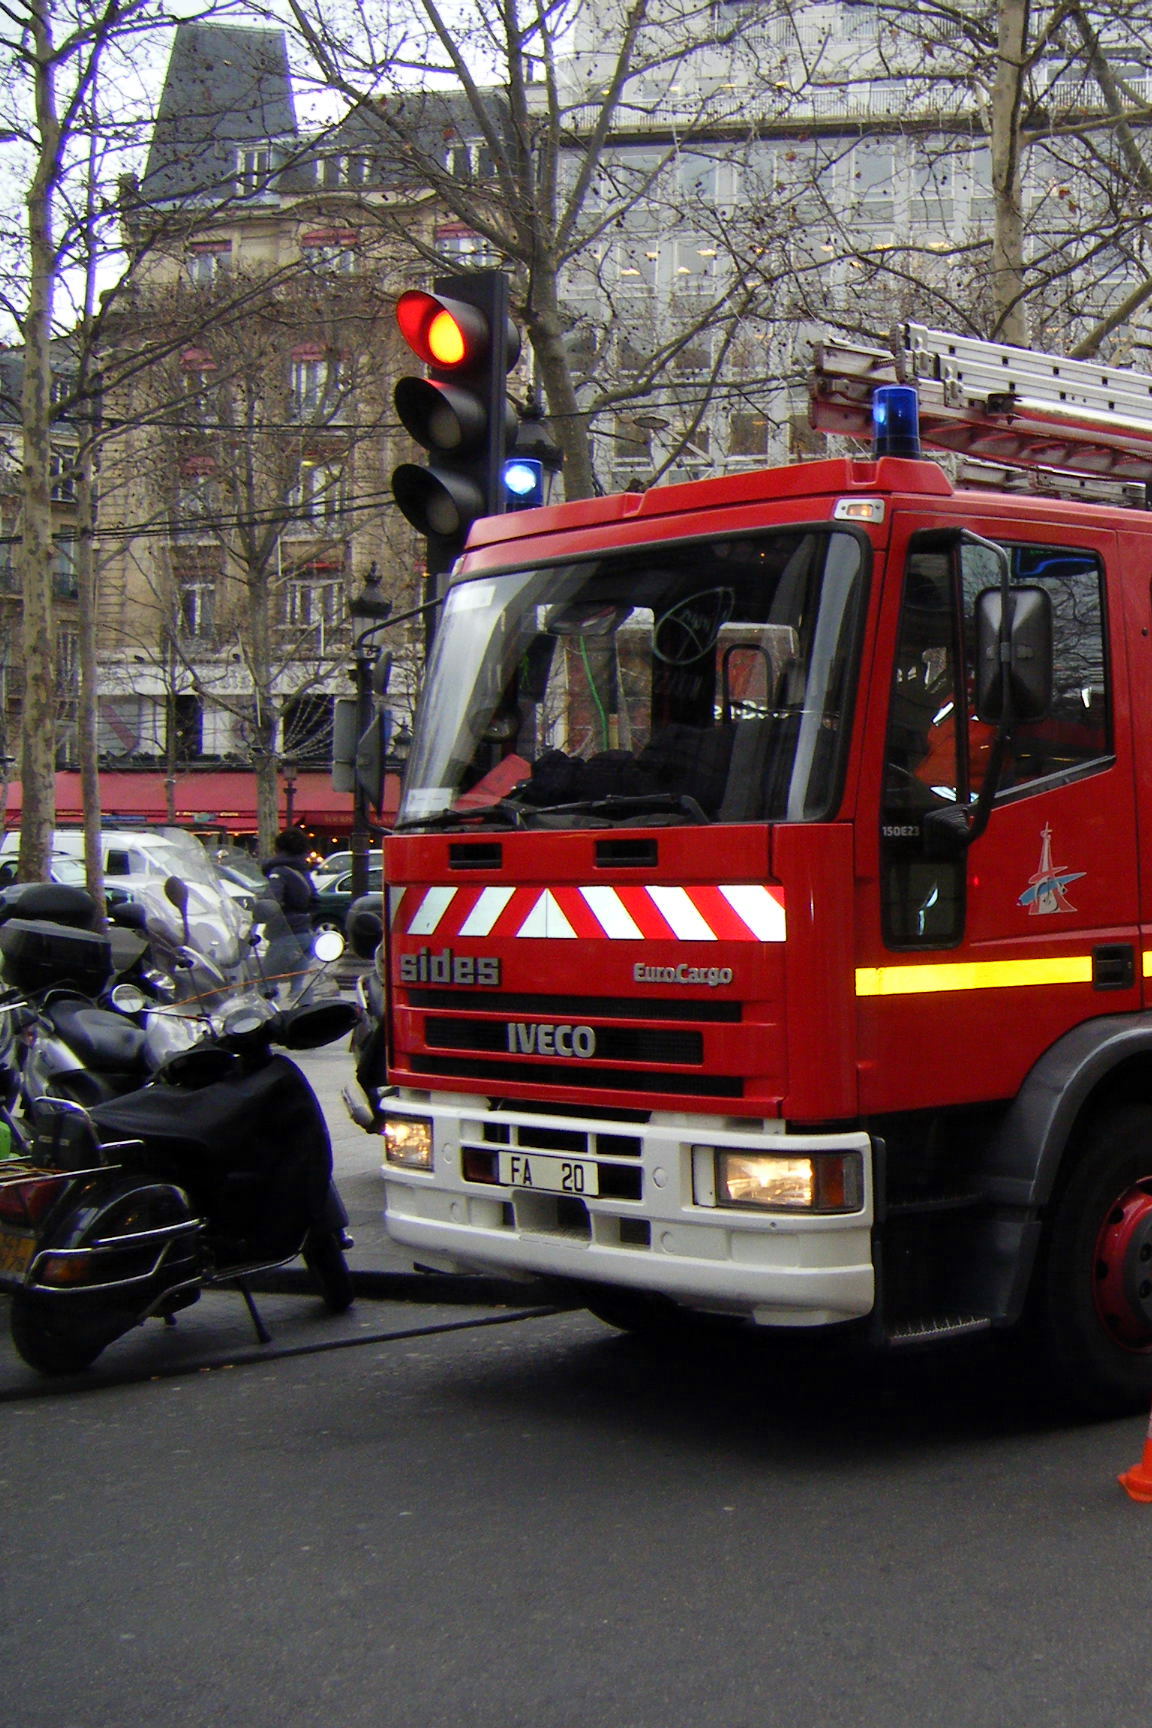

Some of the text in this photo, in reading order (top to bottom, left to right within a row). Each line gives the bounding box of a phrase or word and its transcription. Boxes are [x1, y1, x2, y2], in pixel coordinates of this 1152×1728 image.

[401, 948, 499, 985] sides
[633, 963, 733, 986] EuroCargo
[508, 1022, 595, 1058] IVECO
[511, 1156, 584, 1192] FA 20
